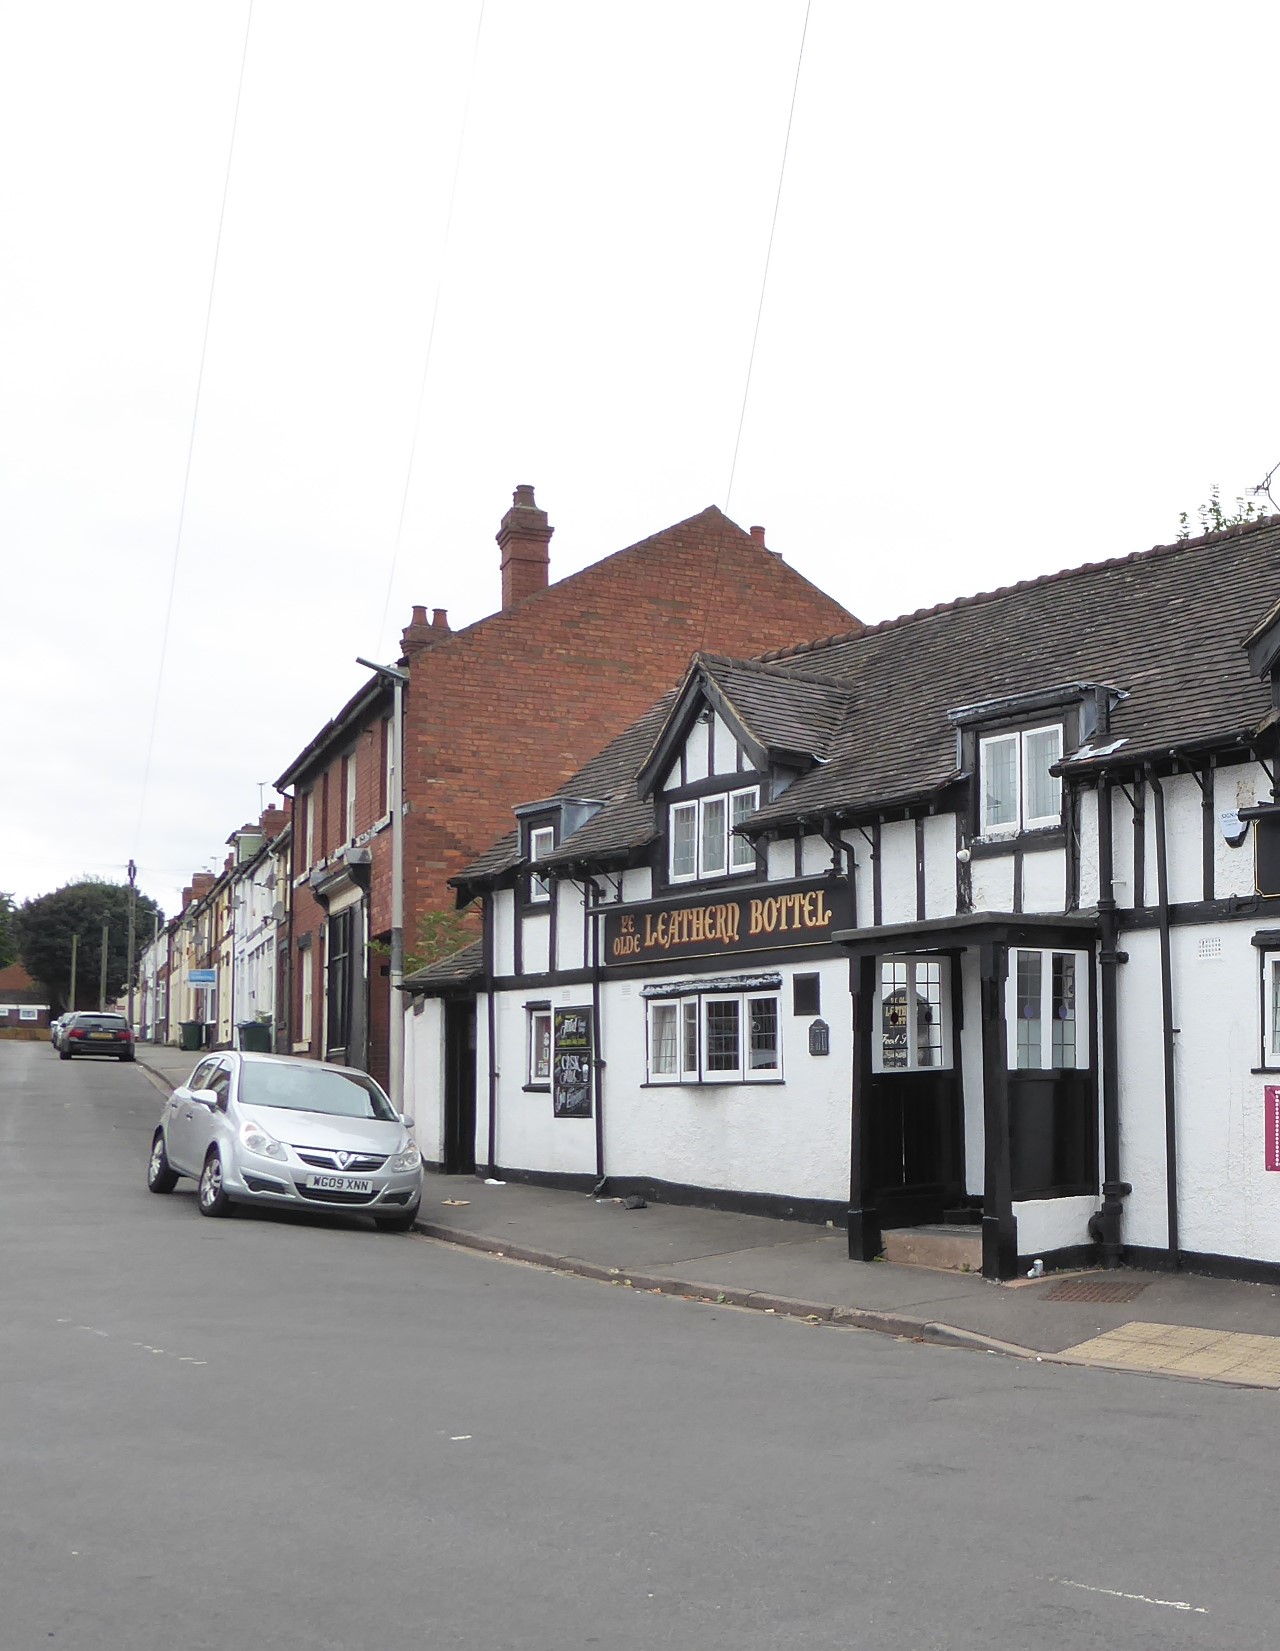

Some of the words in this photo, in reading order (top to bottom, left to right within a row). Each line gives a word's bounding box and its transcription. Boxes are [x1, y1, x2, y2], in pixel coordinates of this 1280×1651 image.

[620, 915, 635, 933] YE
[643, 902, 741, 949] LEATHERN
[749, 889, 833, 934] BOTTEL
[613, 933, 641, 956] OLDE
[313, 1176, 344, 1188] WG09
[346, 1179, 369, 1191] XNN
